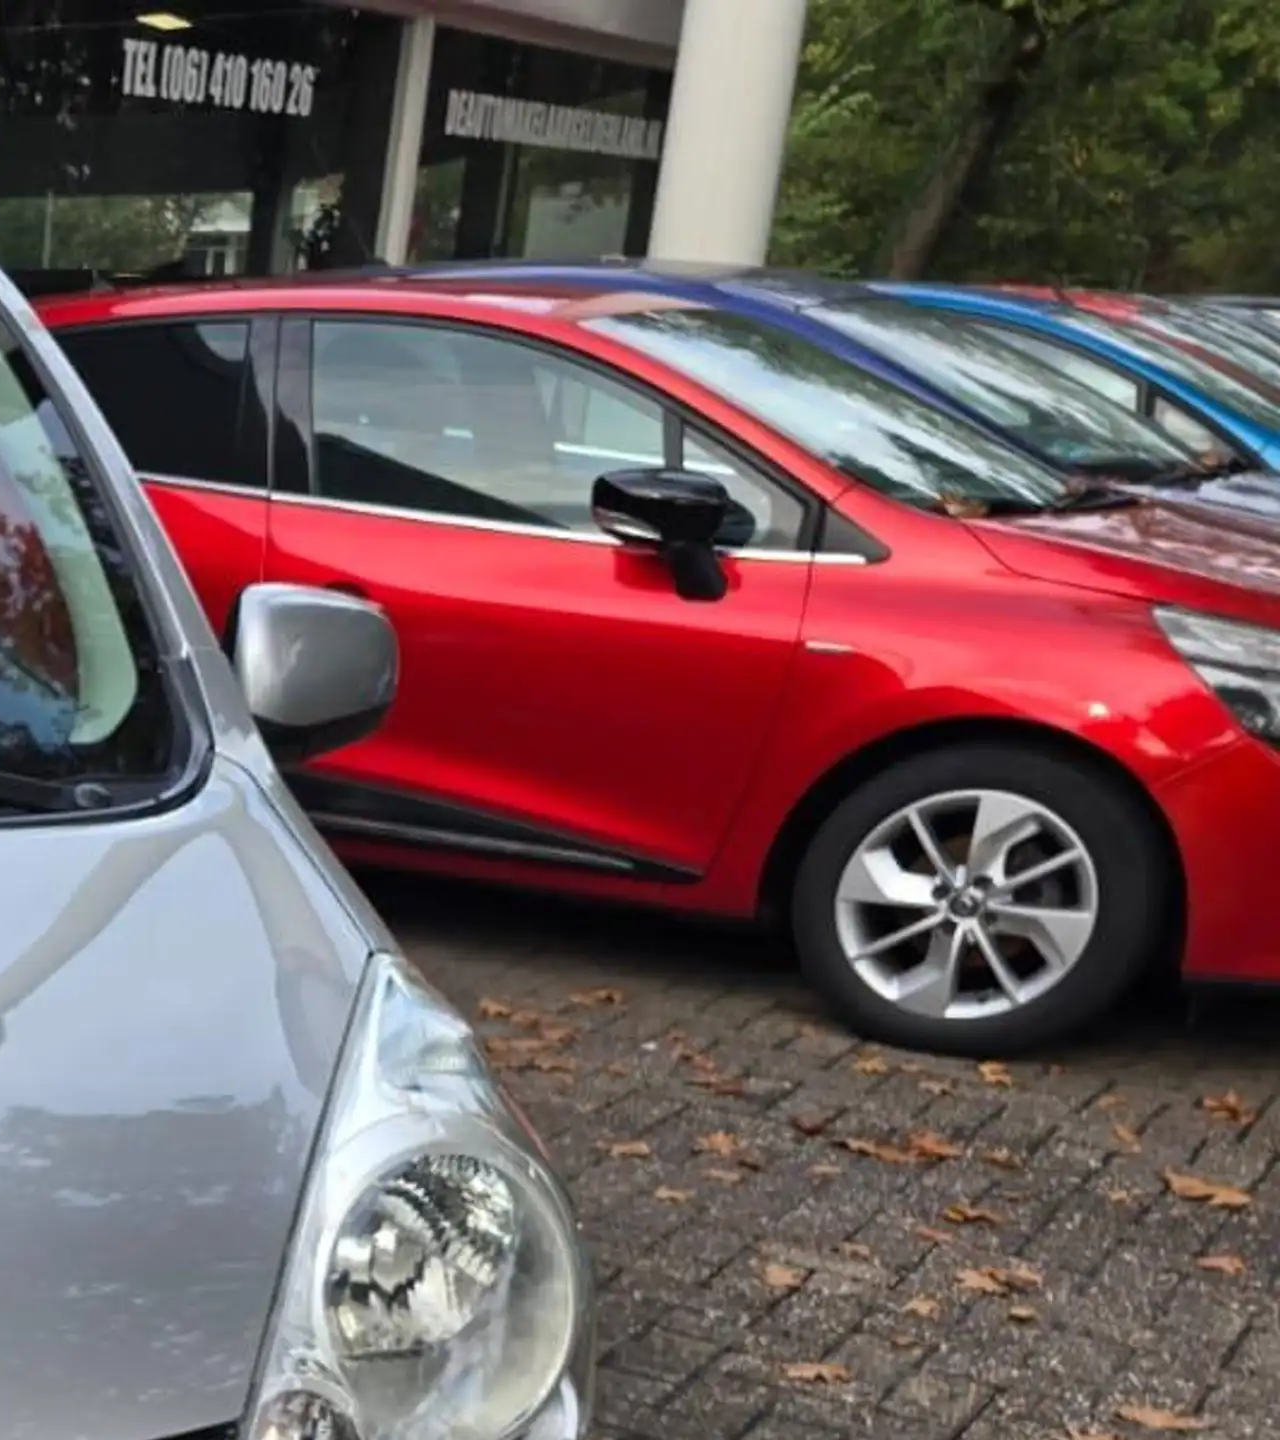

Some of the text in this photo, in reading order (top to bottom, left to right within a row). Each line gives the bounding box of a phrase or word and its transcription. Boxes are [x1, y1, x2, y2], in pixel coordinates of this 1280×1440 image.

[123, 38, 157, 97] TEL
[209, 52, 248, 109] 410
[250, 58, 287, 114] 160
[286, 62, 316, 117] 26
